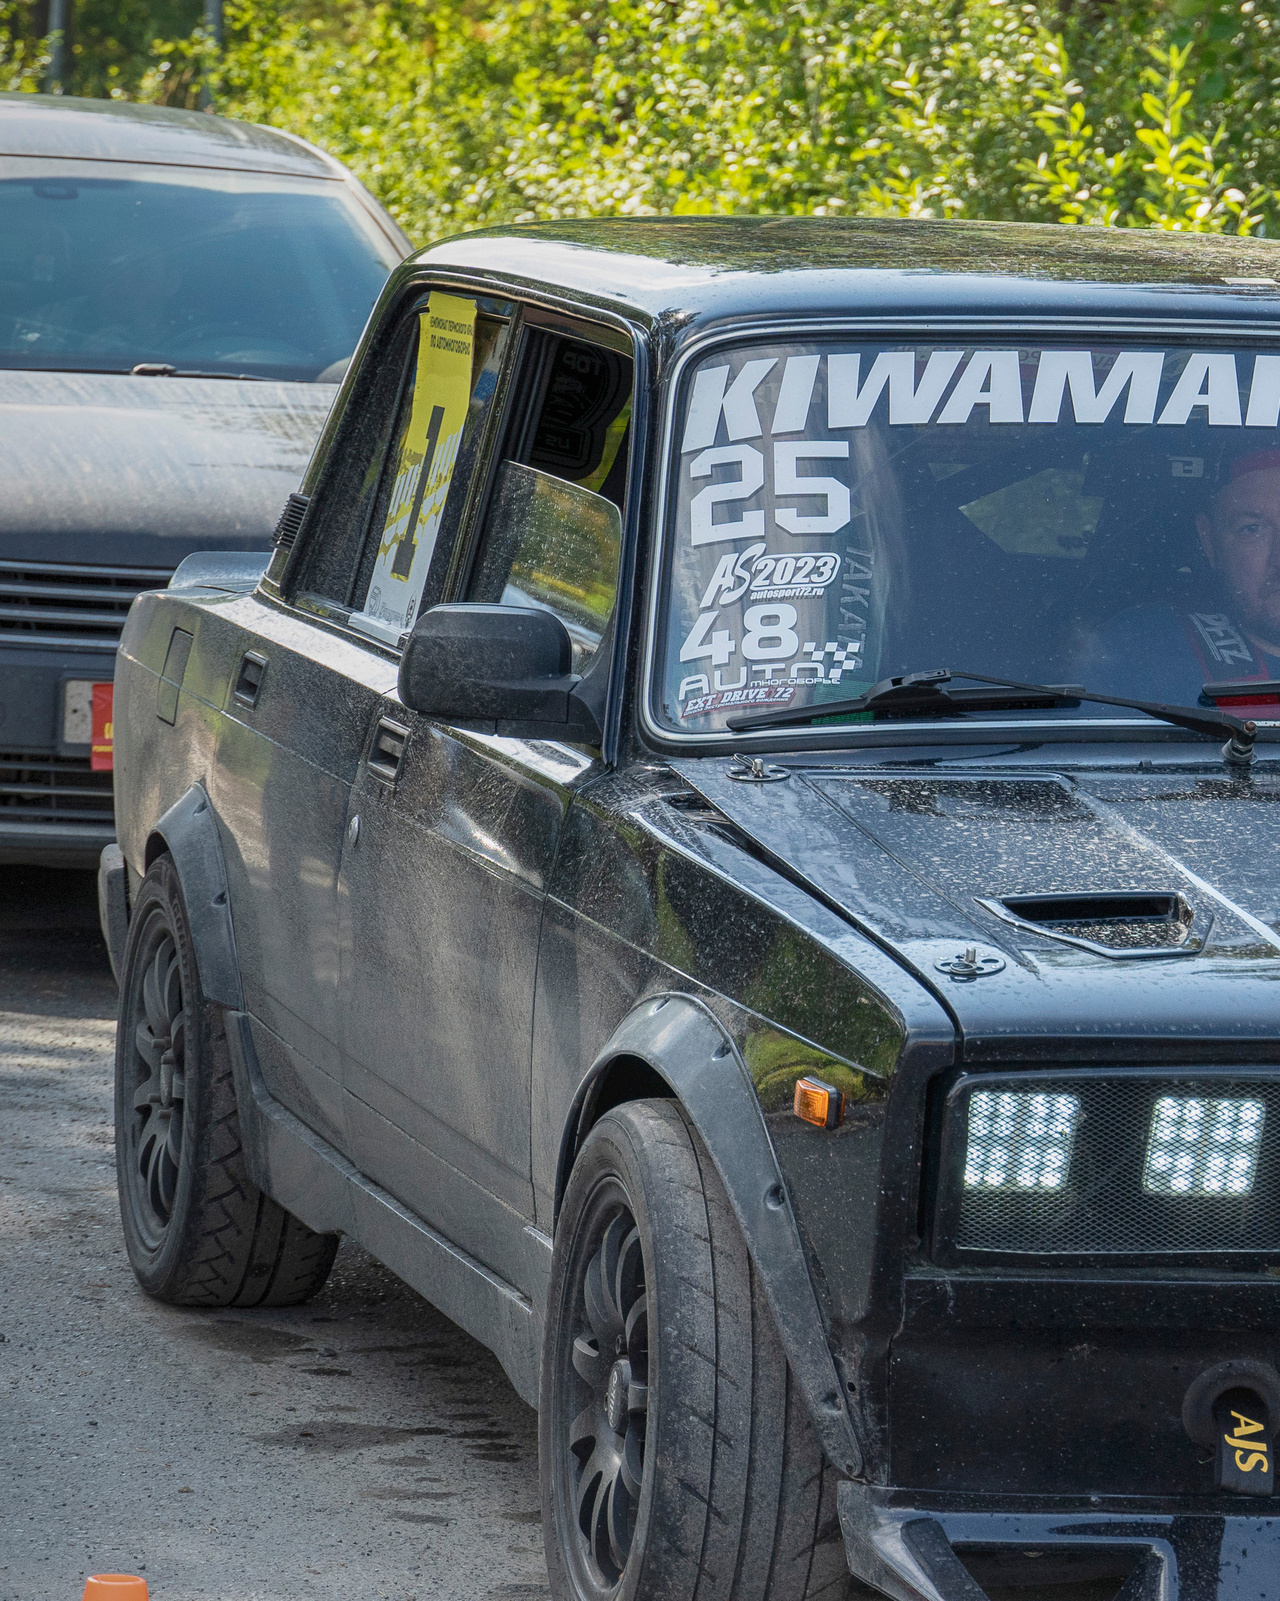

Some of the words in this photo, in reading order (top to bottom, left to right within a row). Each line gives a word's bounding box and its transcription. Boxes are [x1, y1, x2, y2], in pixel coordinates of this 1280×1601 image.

[690, 441, 850, 546] 25
[750, 587, 825, 601] autosport72.ru
[751, 556, 835, 587] 2023
[679, 603, 799, 666] 48
[686, 694, 717, 712] EXT
[721, 687, 768, 703] DRIVE
[774, 687, 794, 698] 72
[1224, 1410, 1269, 1474] AJS
